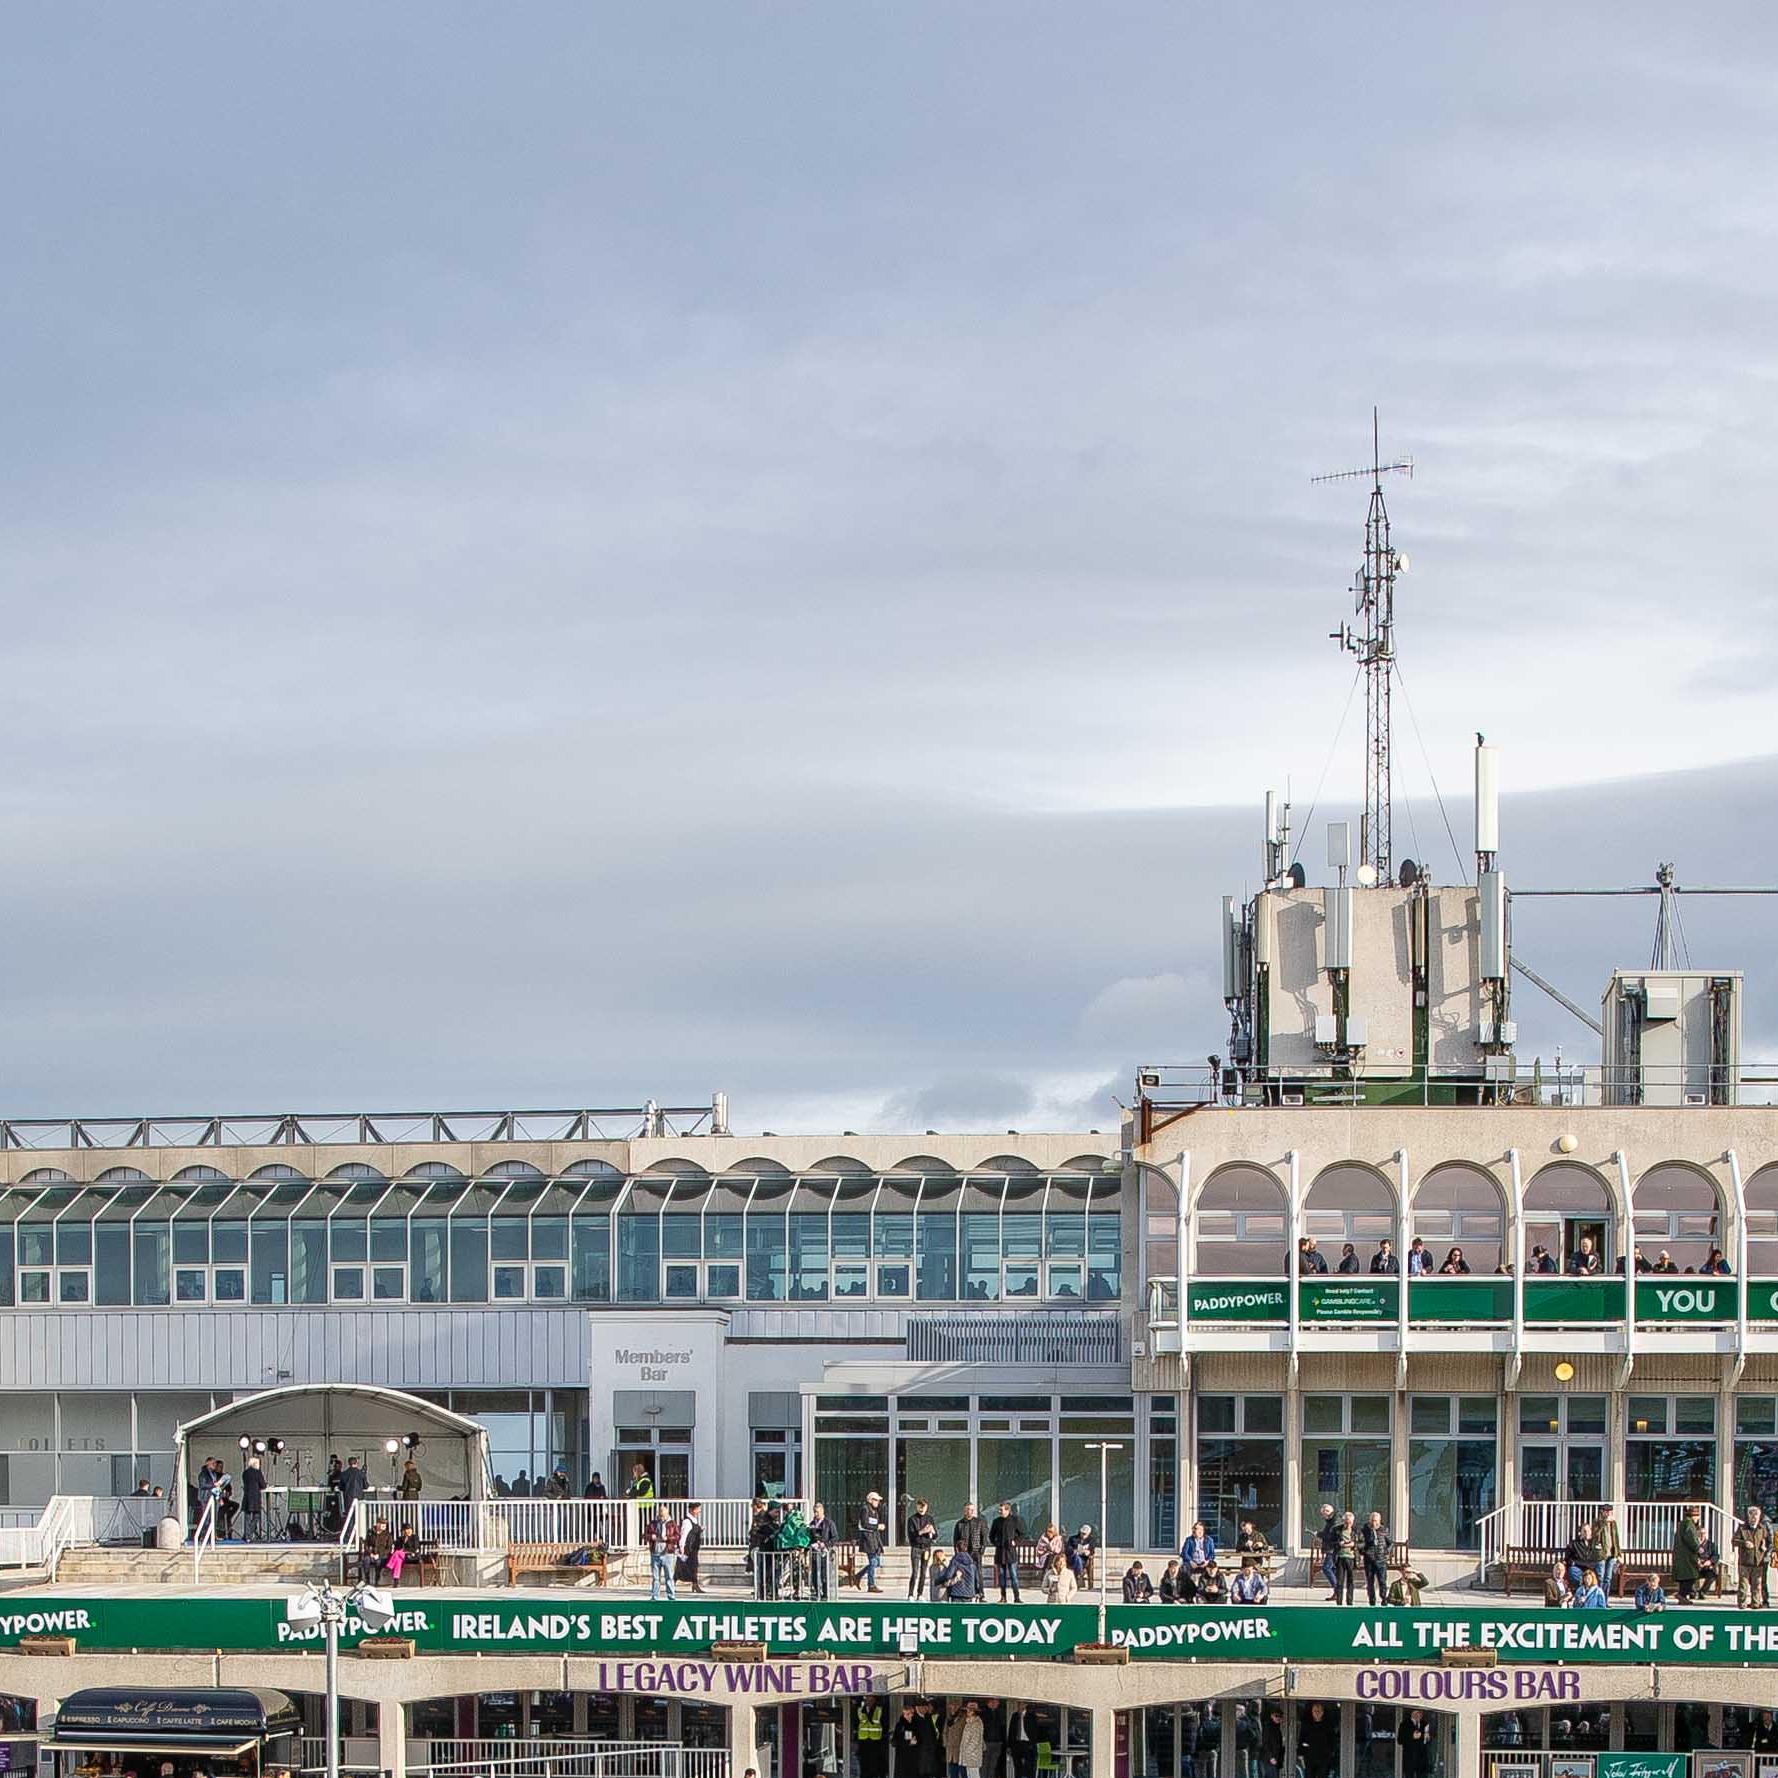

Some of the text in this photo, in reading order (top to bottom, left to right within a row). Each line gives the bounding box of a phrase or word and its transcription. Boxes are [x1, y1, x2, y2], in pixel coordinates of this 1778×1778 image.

[1656, 1290, 1715, 1313] YOU
[614, 1350, 694, 1366] Members'
[640, 1367, 668, 1381] Bar
[452, 1614, 1062, 1645] IRELAND'S BEST ATHLETES ARE HERE TODAY
[1351, 1621, 1403, 1648] ALL
[1413, 1621, 1470, 1648] THE
[1480, 1622, 1664, 1651] EXCITEMENT
[1672, 1624, 1715, 1651] OF
[598, 1663, 873, 1694] LEGACY WINE BAR
[1355, 1670, 1581, 1700] COLOURS BAR
